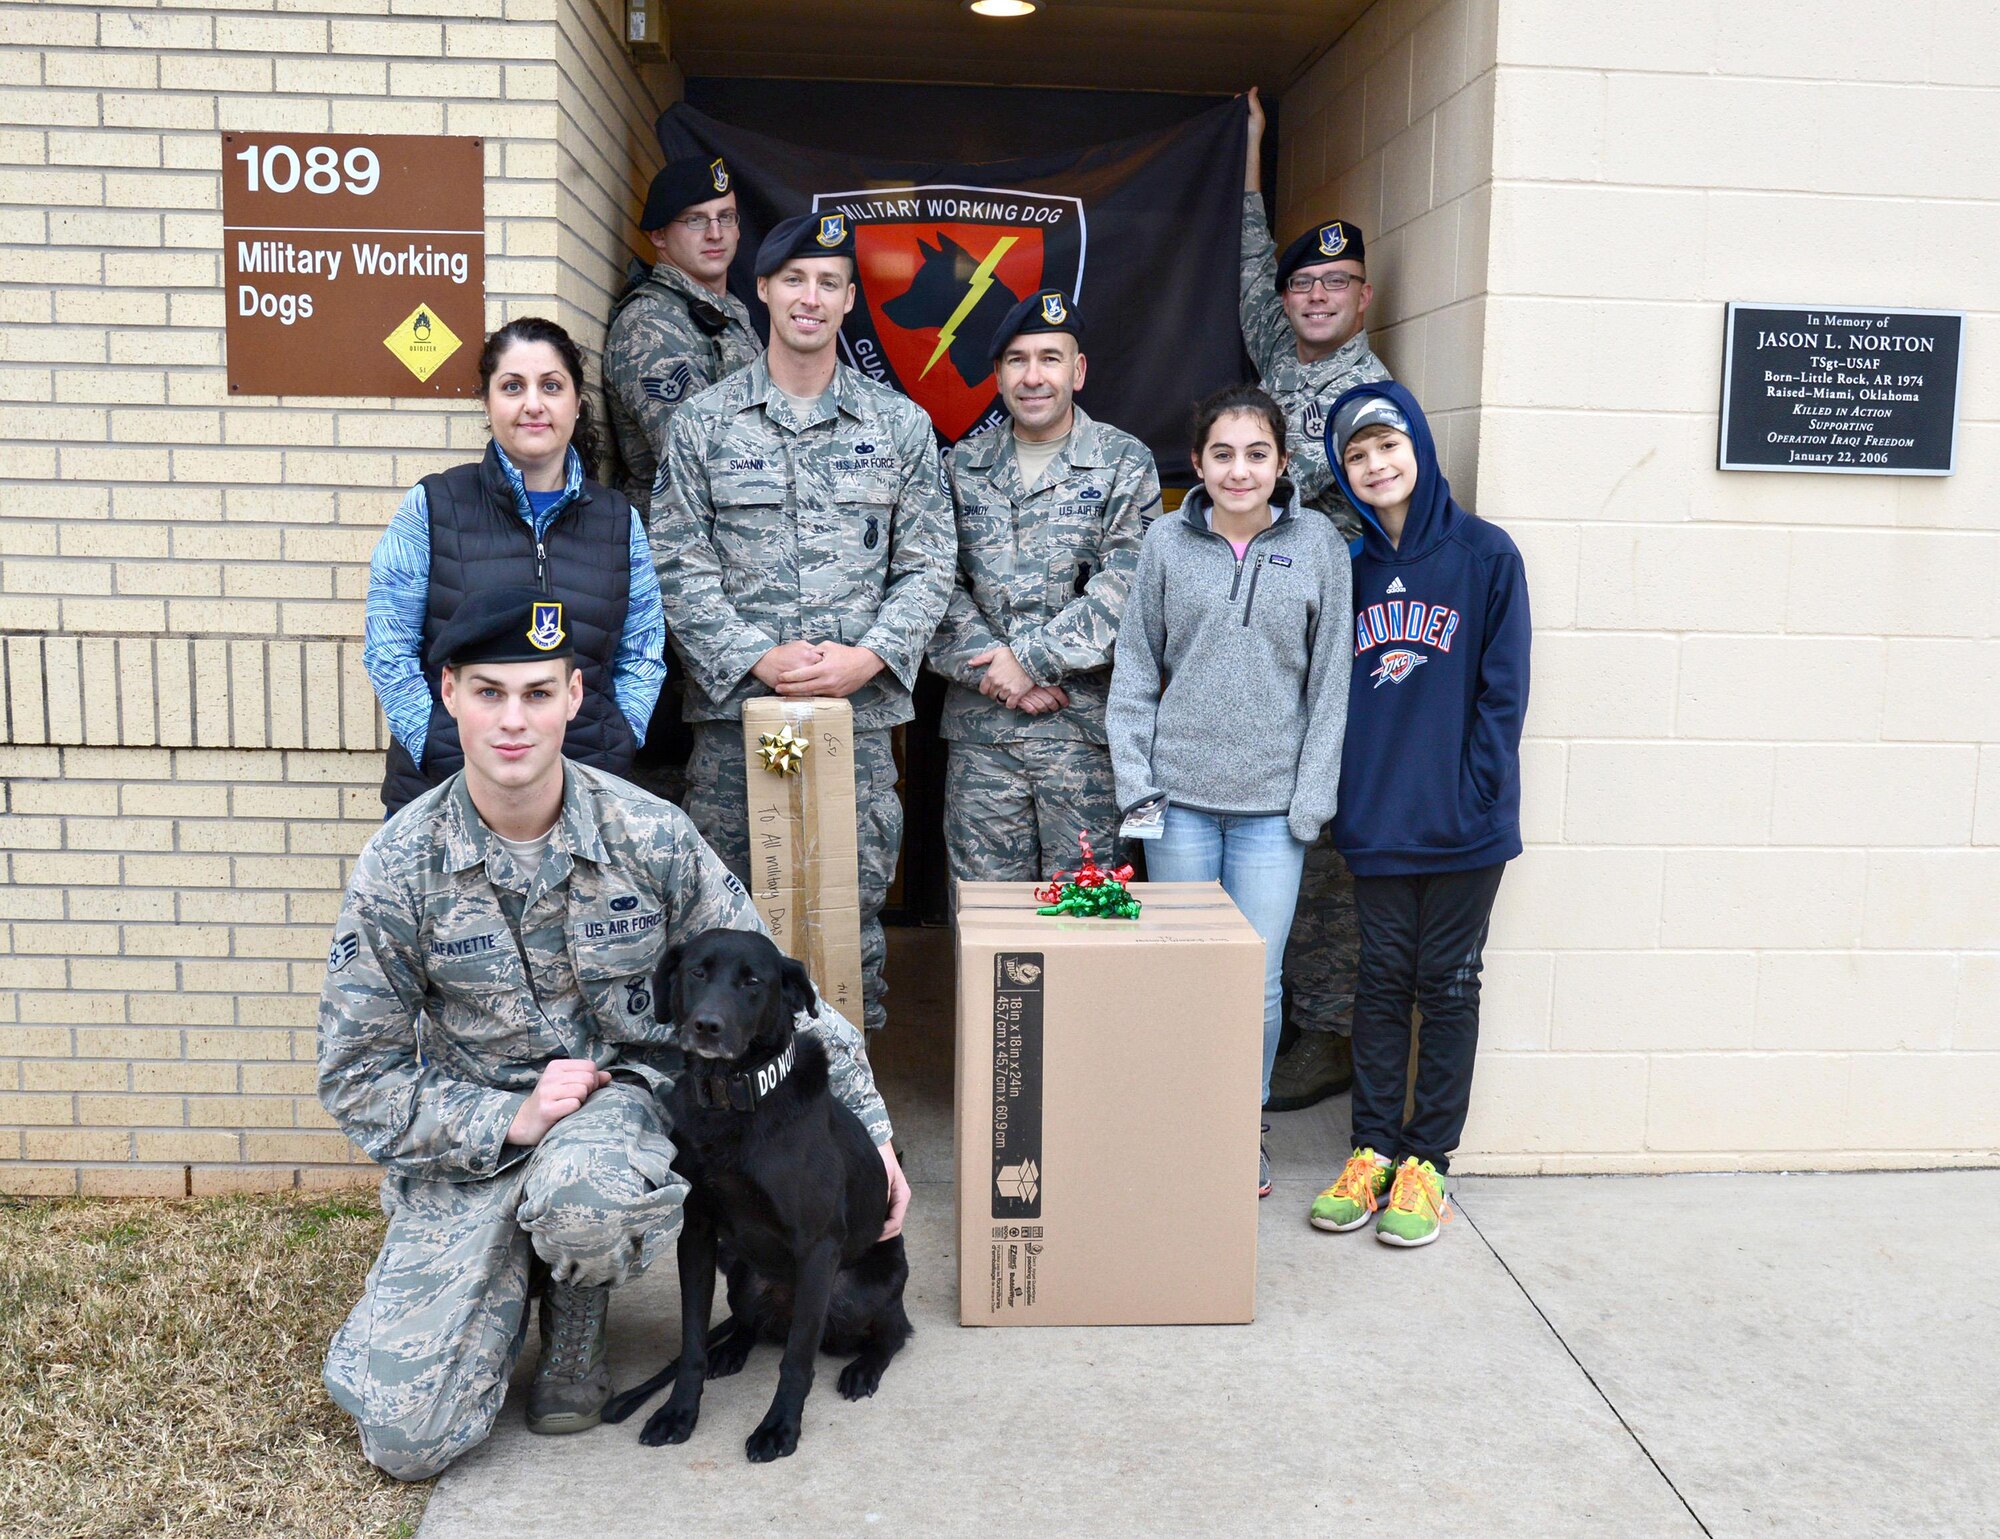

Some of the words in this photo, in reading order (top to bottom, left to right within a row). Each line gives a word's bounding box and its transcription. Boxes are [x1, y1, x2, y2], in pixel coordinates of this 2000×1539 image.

[236, 144, 381, 196] 1089
[836, 199, 921, 220] MILITARY
[926, 199, 1018, 221] WORKING
[1021, 206, 1063, 224] DOG
[237, 241, 342, 281] Military
[352, 243, 468, 284] Working
[238, 285, 314, 325] Dogs
[1807, 314, 1820, 326] In
[1824, 315, 1873, 331] Memory
[1876, 316, 1890, 328] of
[1756, 331, 1819, 350] JASON
[1825, 334, 1842, 350] L.
[1849, 335, 1935, 353] NORTON
[1837, 373, 1870, 386] Rock,
[1873, 375, 1892, 386] AR
[1897, 375, 1924, 387] 1974
[1859, 389, 1920, 402] Oklahoma
[1792, 404, 1832, 416] KILLED
[1835, 408, 1848, 416] IN
[1850, 406, 1893, 418] ACTION
[1808, 418, 1874, 432] SUPPORTING
[1767, 431, 1828, 445] OPERATION
[1830, 434, 1861, 447] IRAQI
[1863, 435, 1915, 448] FREEDOM
[730, 459, 764, 471] SWANN
[854, 458, 870, 470] AIR
[870, 457, 895, 469] FORCE
[1788, 450, 1834, 465] January
[1837, 452, 1856, 464] 22,
[1860, 452, 1889, 464] 2006
[964, 504, 990, 516] SHADY
[1077, 504, 1092, 516] AIR
[1354, 600, 1459, 657] HUNDER
[757, 804, 782, 823] To
[760, 833, 782, 850] All
[760, 855, 782, 901] military
[609, 920, 630, 935] AIR
[632, 912, 663, 932] FORC
[768, 907, 786, 937] Dogs
[429, 934, 496, 956] LAFAYETTE
[1006, 961, 1019, 981] DUCK
[758, 1063, 777, 1096] DO
